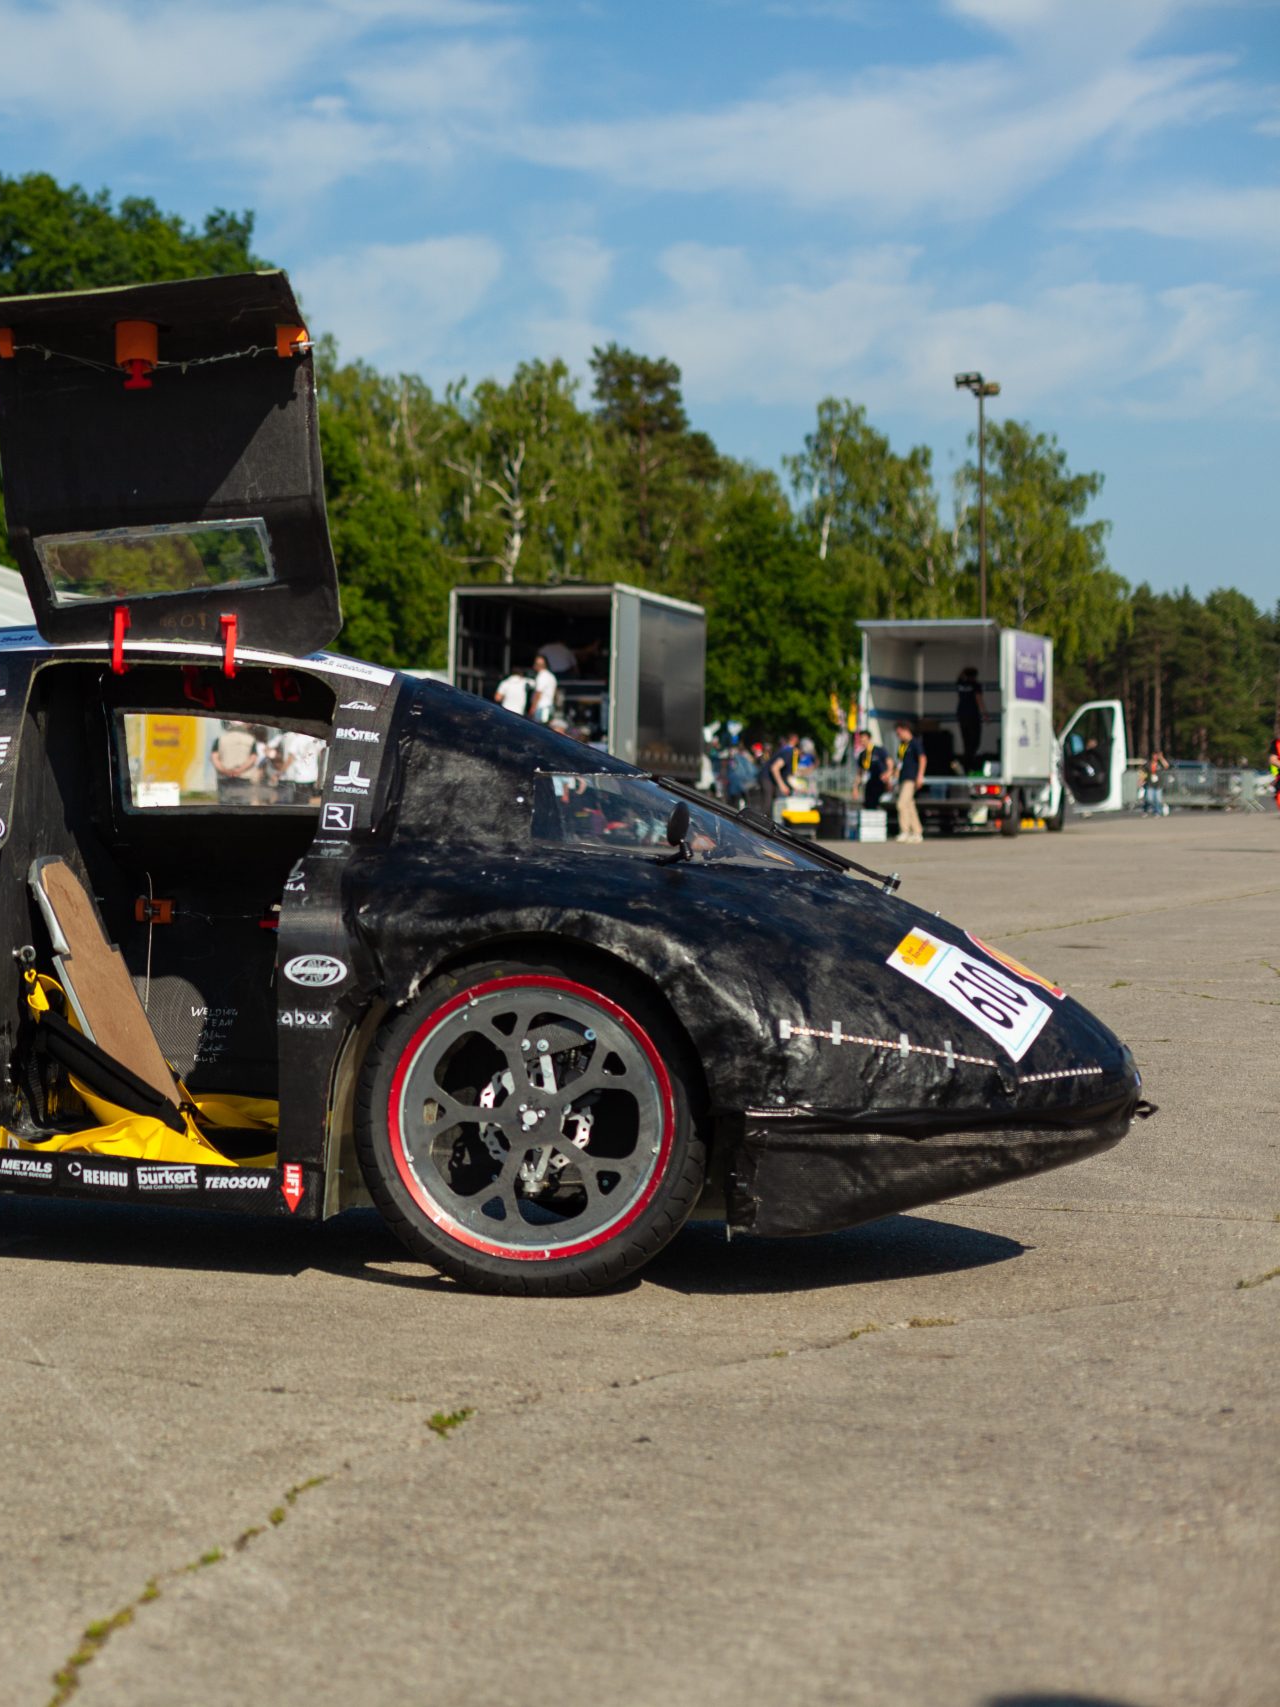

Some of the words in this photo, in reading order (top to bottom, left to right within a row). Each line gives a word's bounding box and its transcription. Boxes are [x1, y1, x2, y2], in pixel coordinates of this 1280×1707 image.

[333, 785, 368, 795] SZINERGIA
[949, 961, 1029, 1029] 610
[1, 1158, 52, 1173] METALS
[83, 1168, 128, 1187] REHAU
[205, 1176, 270, 1189] TEROSON
[286, 1165, 299, 1197] LIFT
